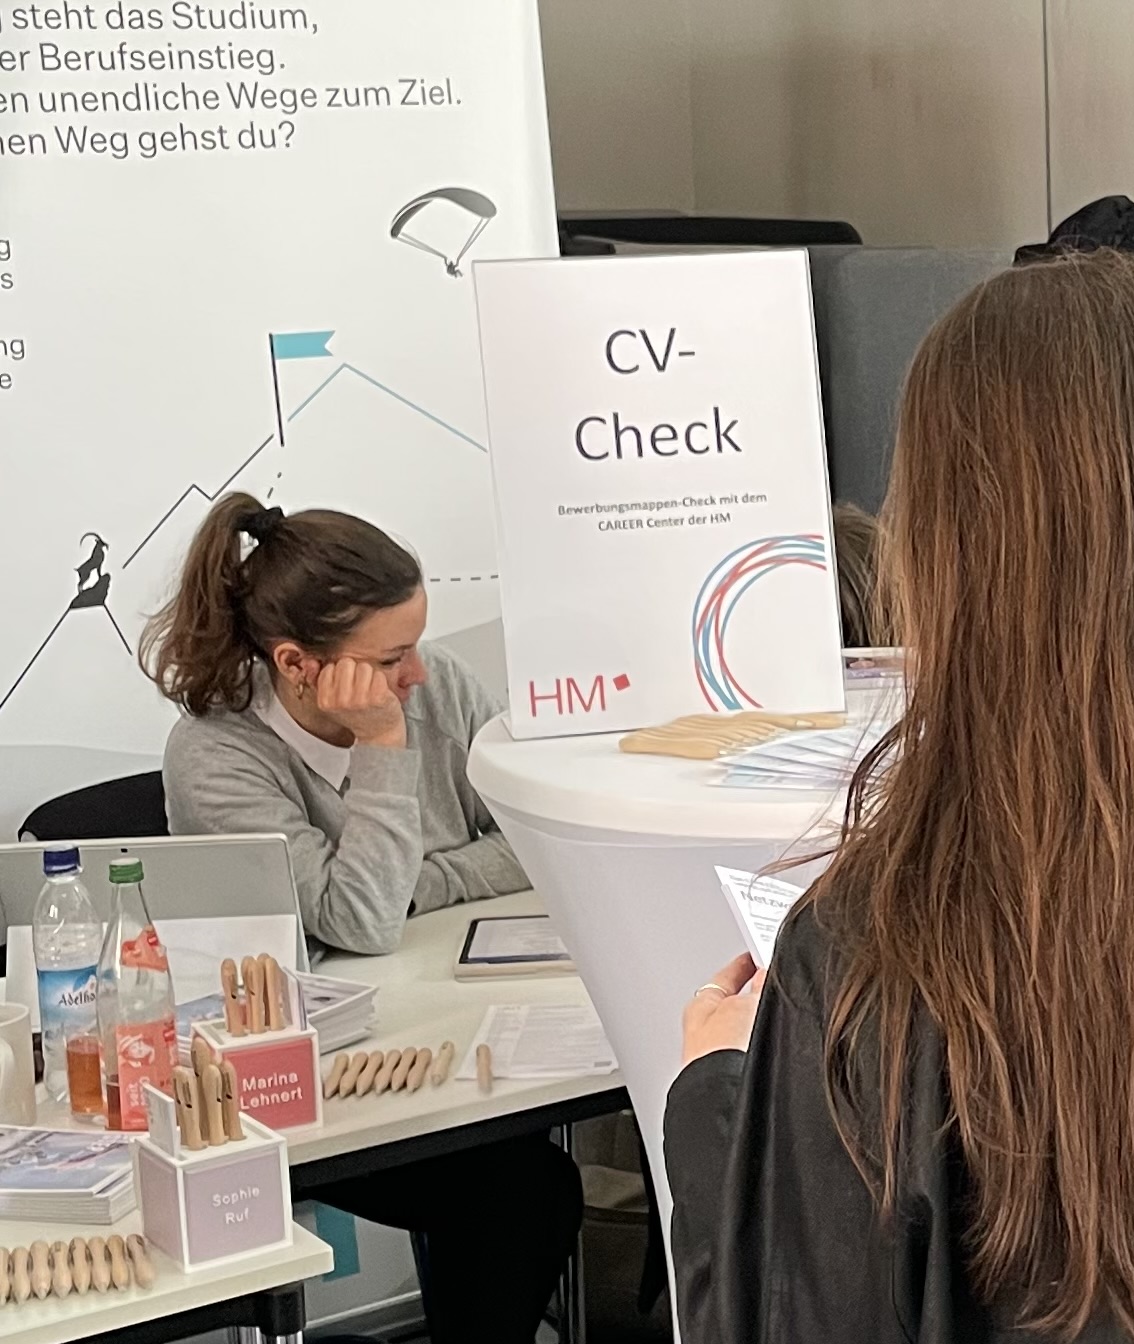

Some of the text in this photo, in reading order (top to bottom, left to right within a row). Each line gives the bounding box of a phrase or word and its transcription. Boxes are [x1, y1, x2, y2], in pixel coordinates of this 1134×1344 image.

[13, 1, 317, 34] steht das Studium,
[39, 42, 285, 75] Berufseinstieg.
[38, 82, 220, 113] unendliche
[226, 81, 318, 114] Wege
[326, 87, 391, 108] zum
[399, 78, 462, 106] Ziel.
[0, 121, 295, 159] en Weg gehst du?
[605, 327, 696, 375] CV-
[575, 406, 742, 461] Check
[558, 492, 768, 515] Bewerbungsmappen-Check mit dem
[598, 512, 731, 531] CAREER Center der HM
[530, 675, 606, 717] HM
[242, 1072, 299, 1092] Marina
[212, 1186, 260, 1207] Sophie
[225, 1208, 250, 1225] Ruf
